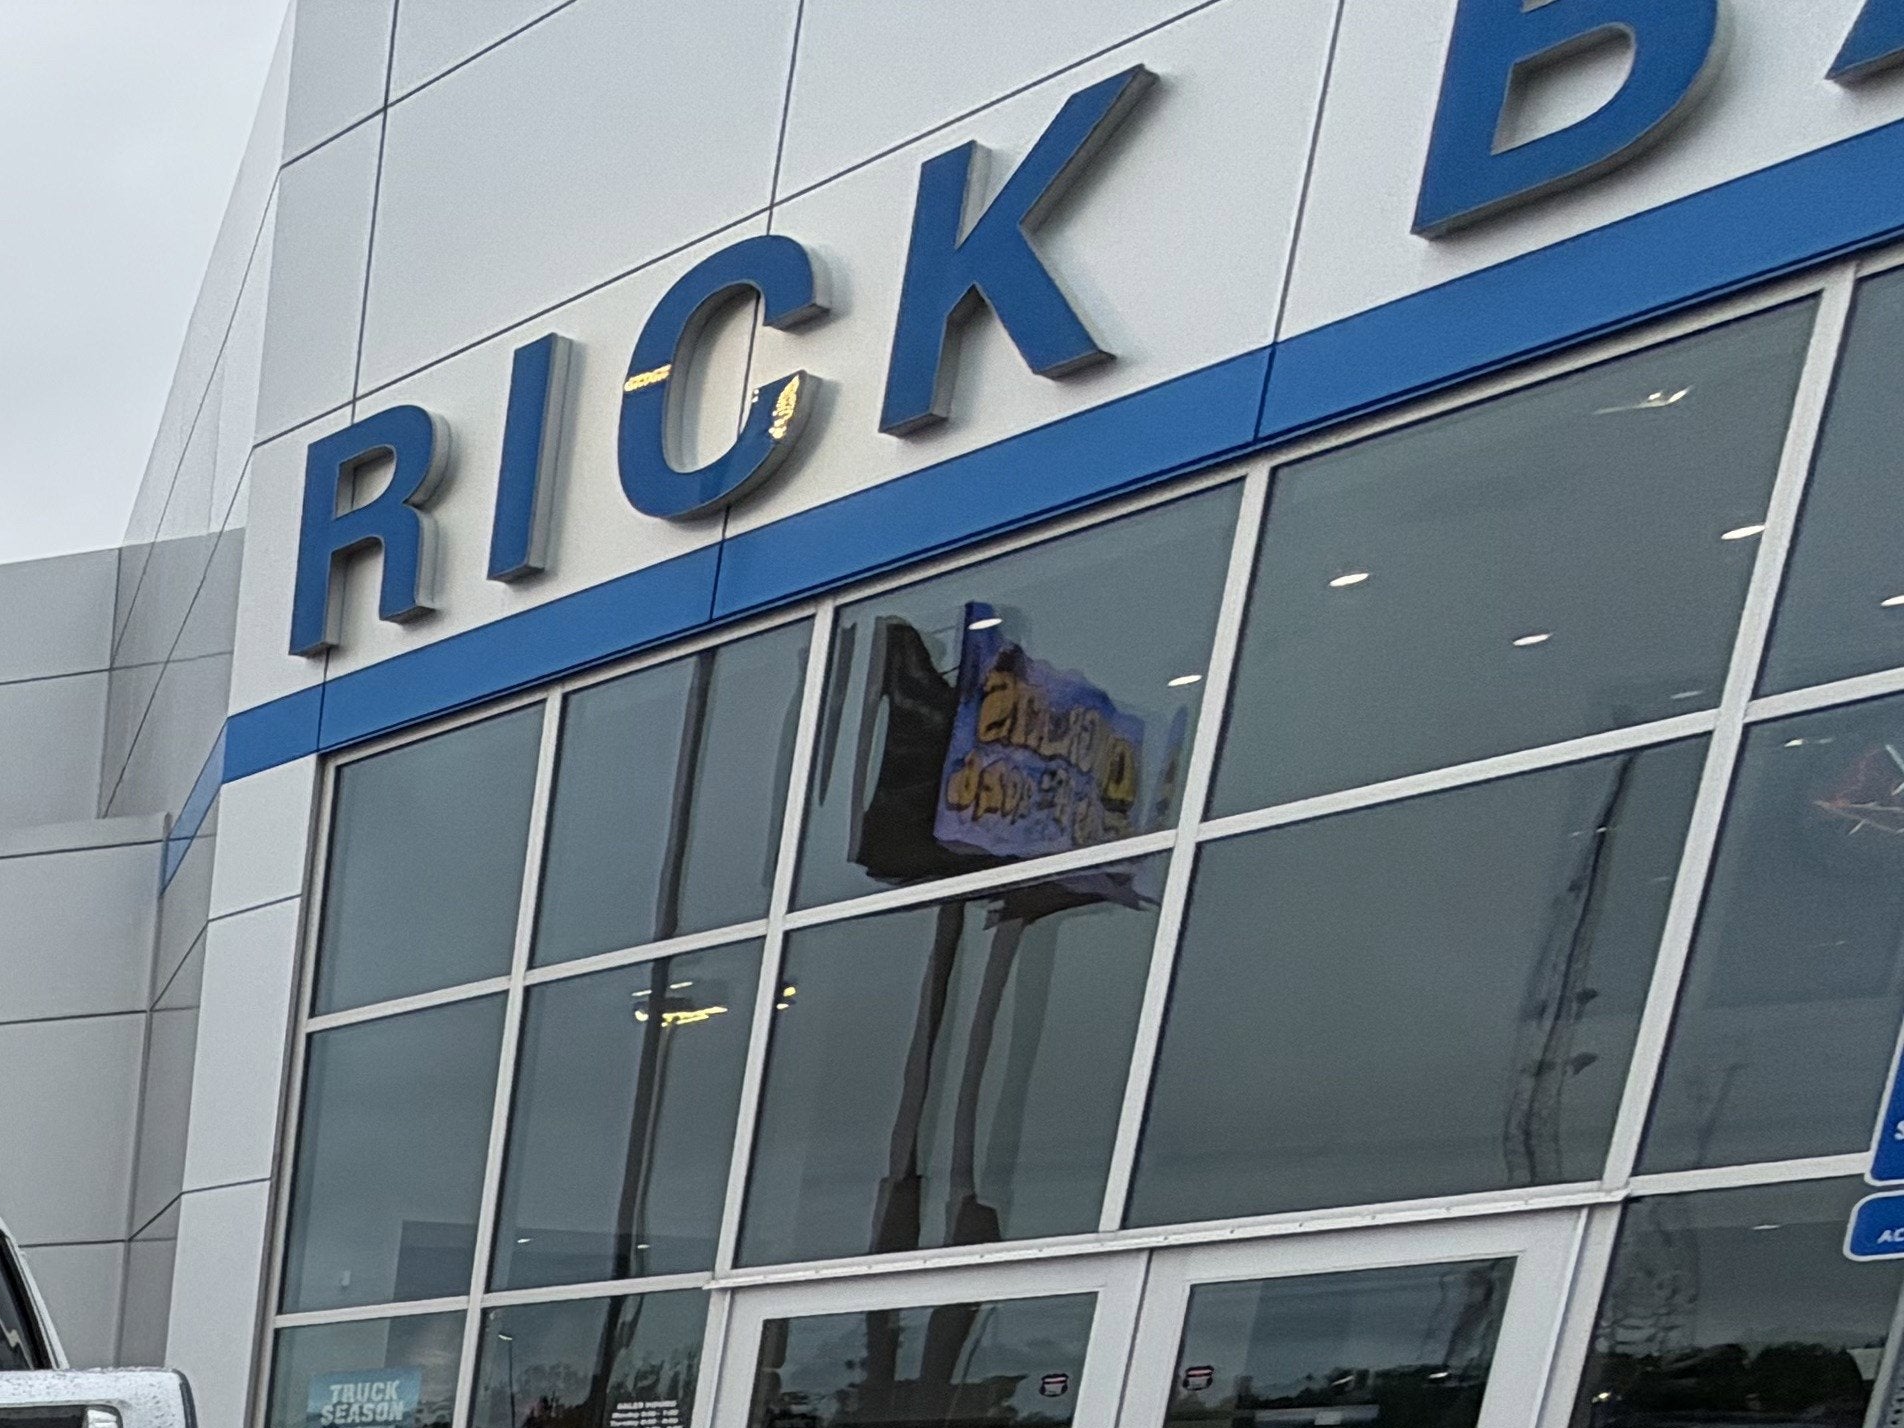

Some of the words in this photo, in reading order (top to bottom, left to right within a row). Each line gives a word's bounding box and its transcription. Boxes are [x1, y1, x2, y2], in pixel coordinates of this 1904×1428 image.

[290, 64, 1158, 658] RICK
[329, 1380, 400, 1402] TRUCK
[320, 1401, 404, 1425] SEASON
